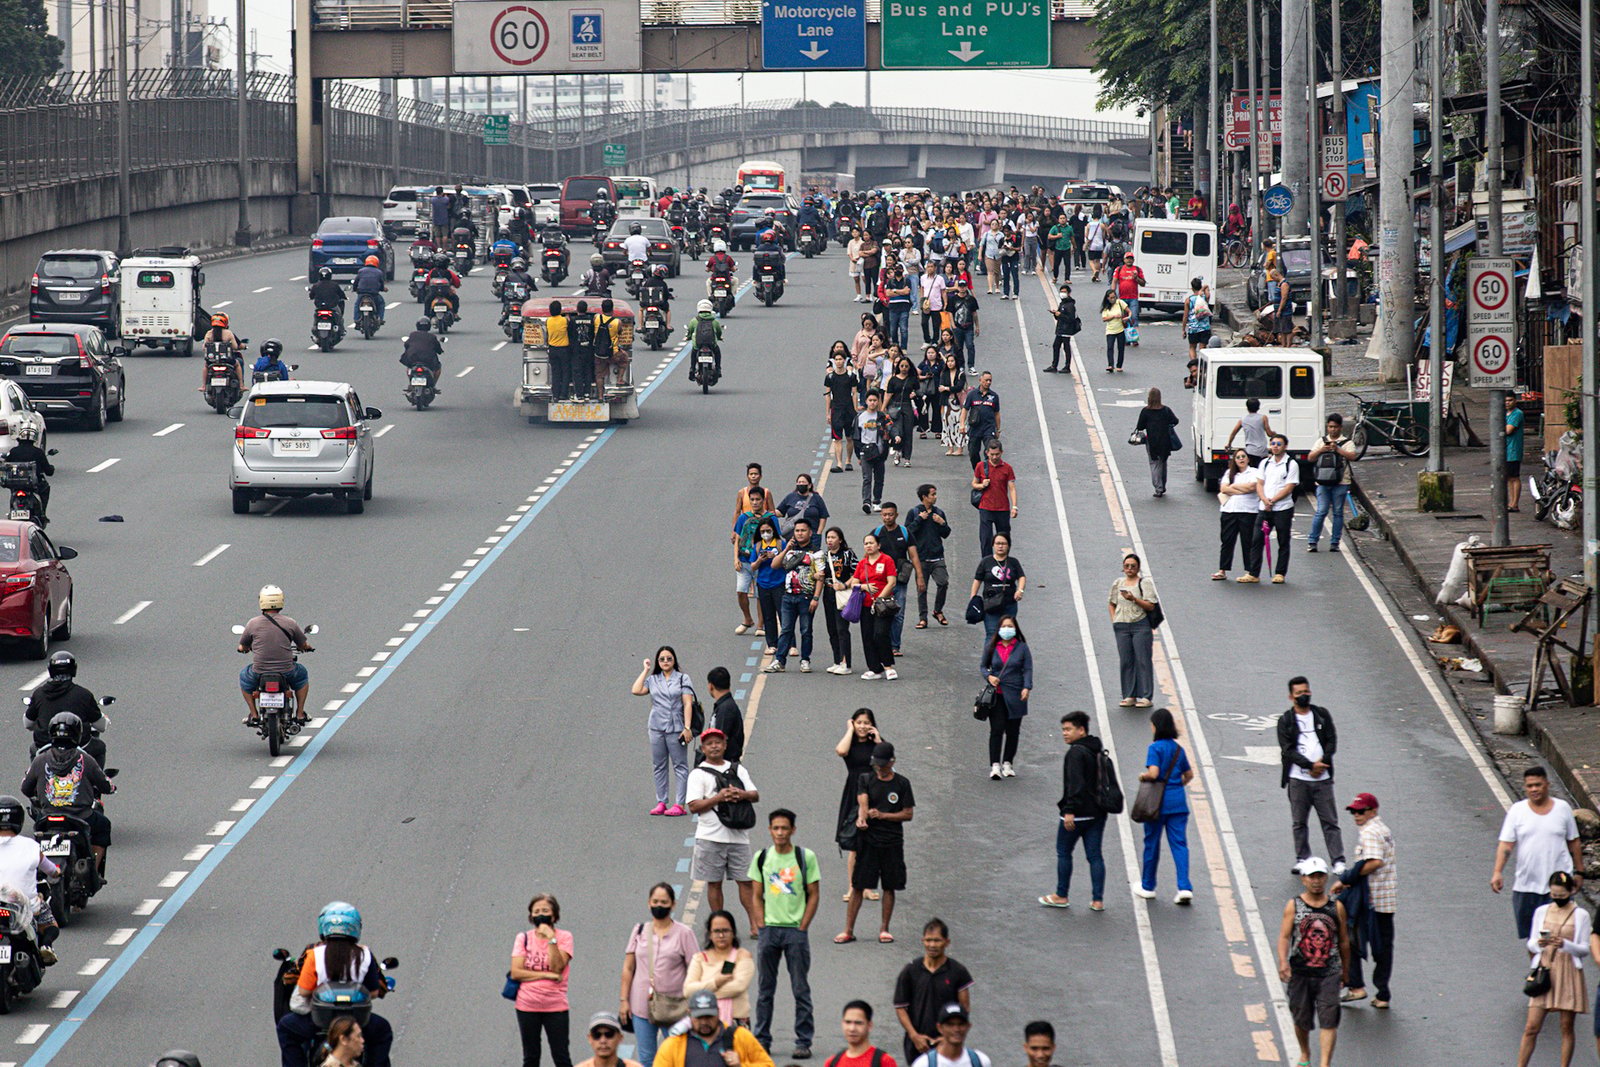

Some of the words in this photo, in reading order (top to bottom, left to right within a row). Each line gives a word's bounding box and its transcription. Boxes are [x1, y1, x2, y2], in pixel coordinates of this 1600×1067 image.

[774, 5, 857, 21] Motorcycle
[890, 3, 927, 16] Bus
[937, 3, 972, 16] and
[986, 2, 1041, 16] PUJ's
[501, 21, 540, 49] 60
[797, 24, 834, 36] Lane
[942, 22, 988, 36] Lane
[1325, 138, 1344, 146] BUS
[1326, 147, 1344, 155] PUJ
[1481, 280, 1500, 294] 50
[1482, 345, 1502, 358] 60
